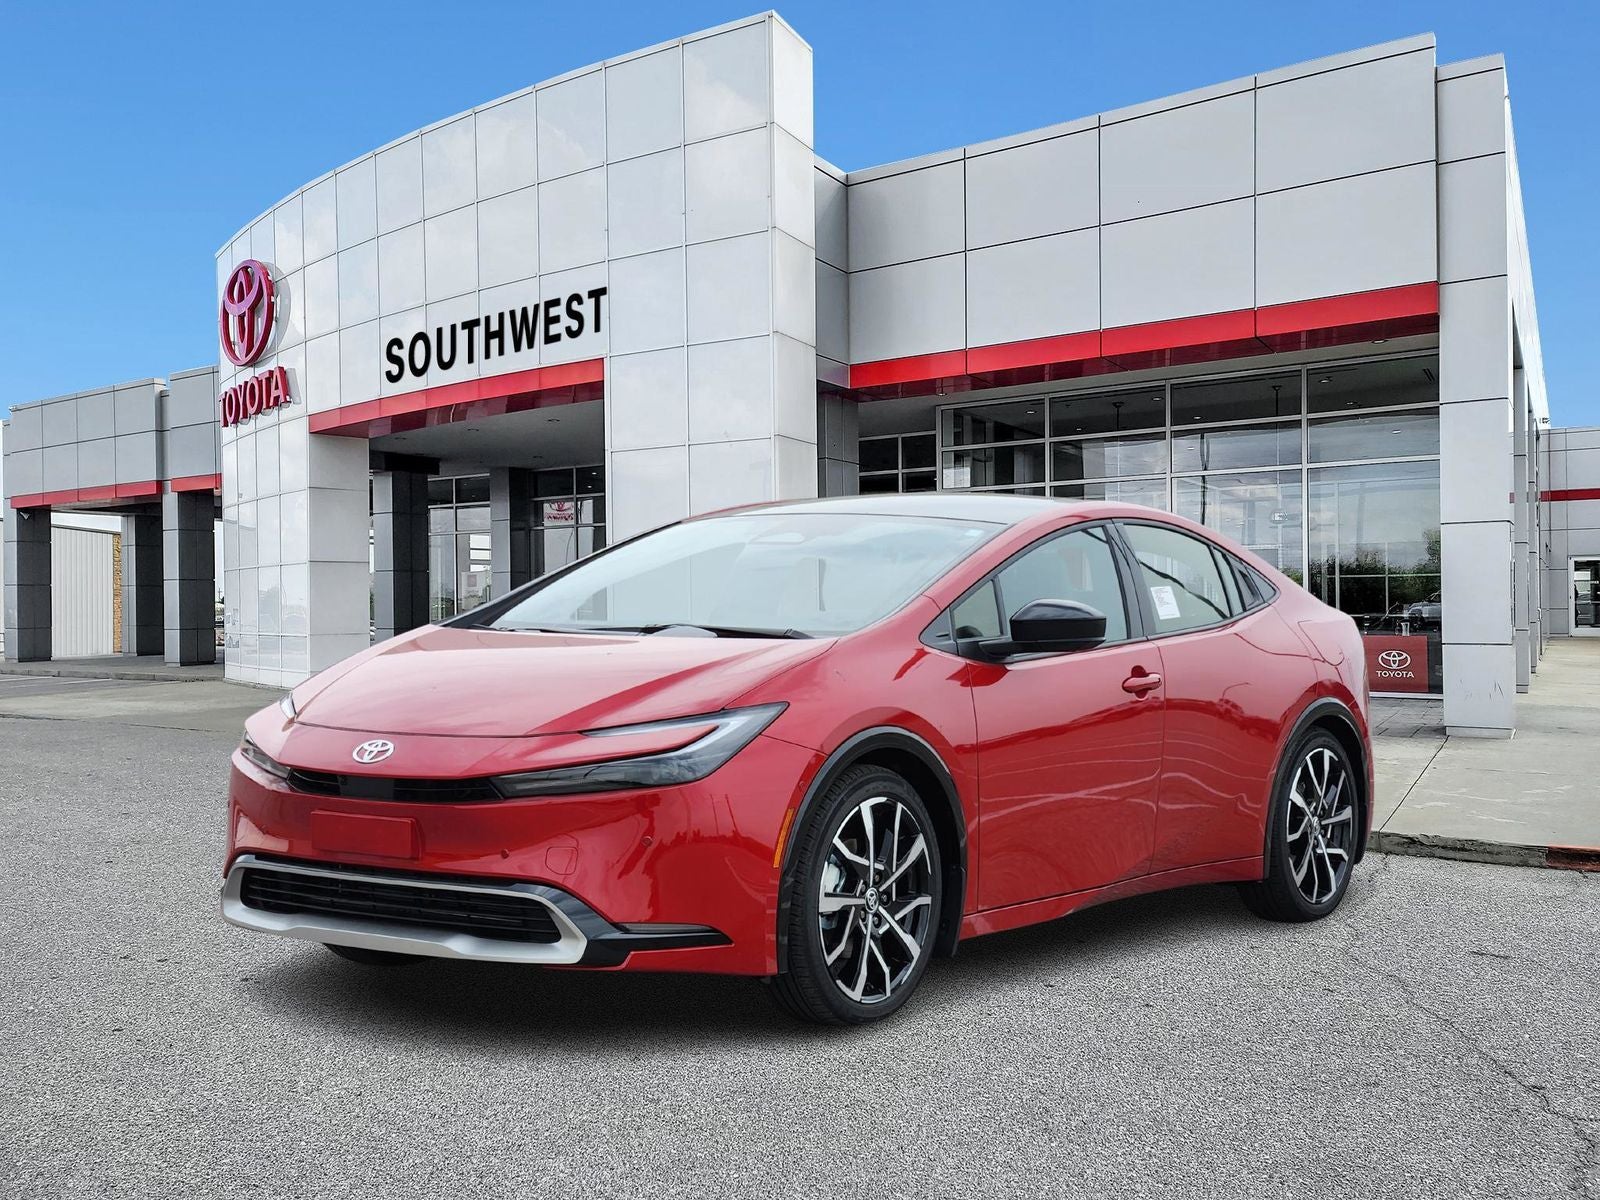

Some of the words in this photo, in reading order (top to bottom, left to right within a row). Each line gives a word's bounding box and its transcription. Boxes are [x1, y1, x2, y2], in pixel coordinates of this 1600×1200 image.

[385, 287, 607, 383] SOUTHWEST
[218, 366, 290, 427] TOYOTA
[1376, 670, 1415, 678] TOYOTA
